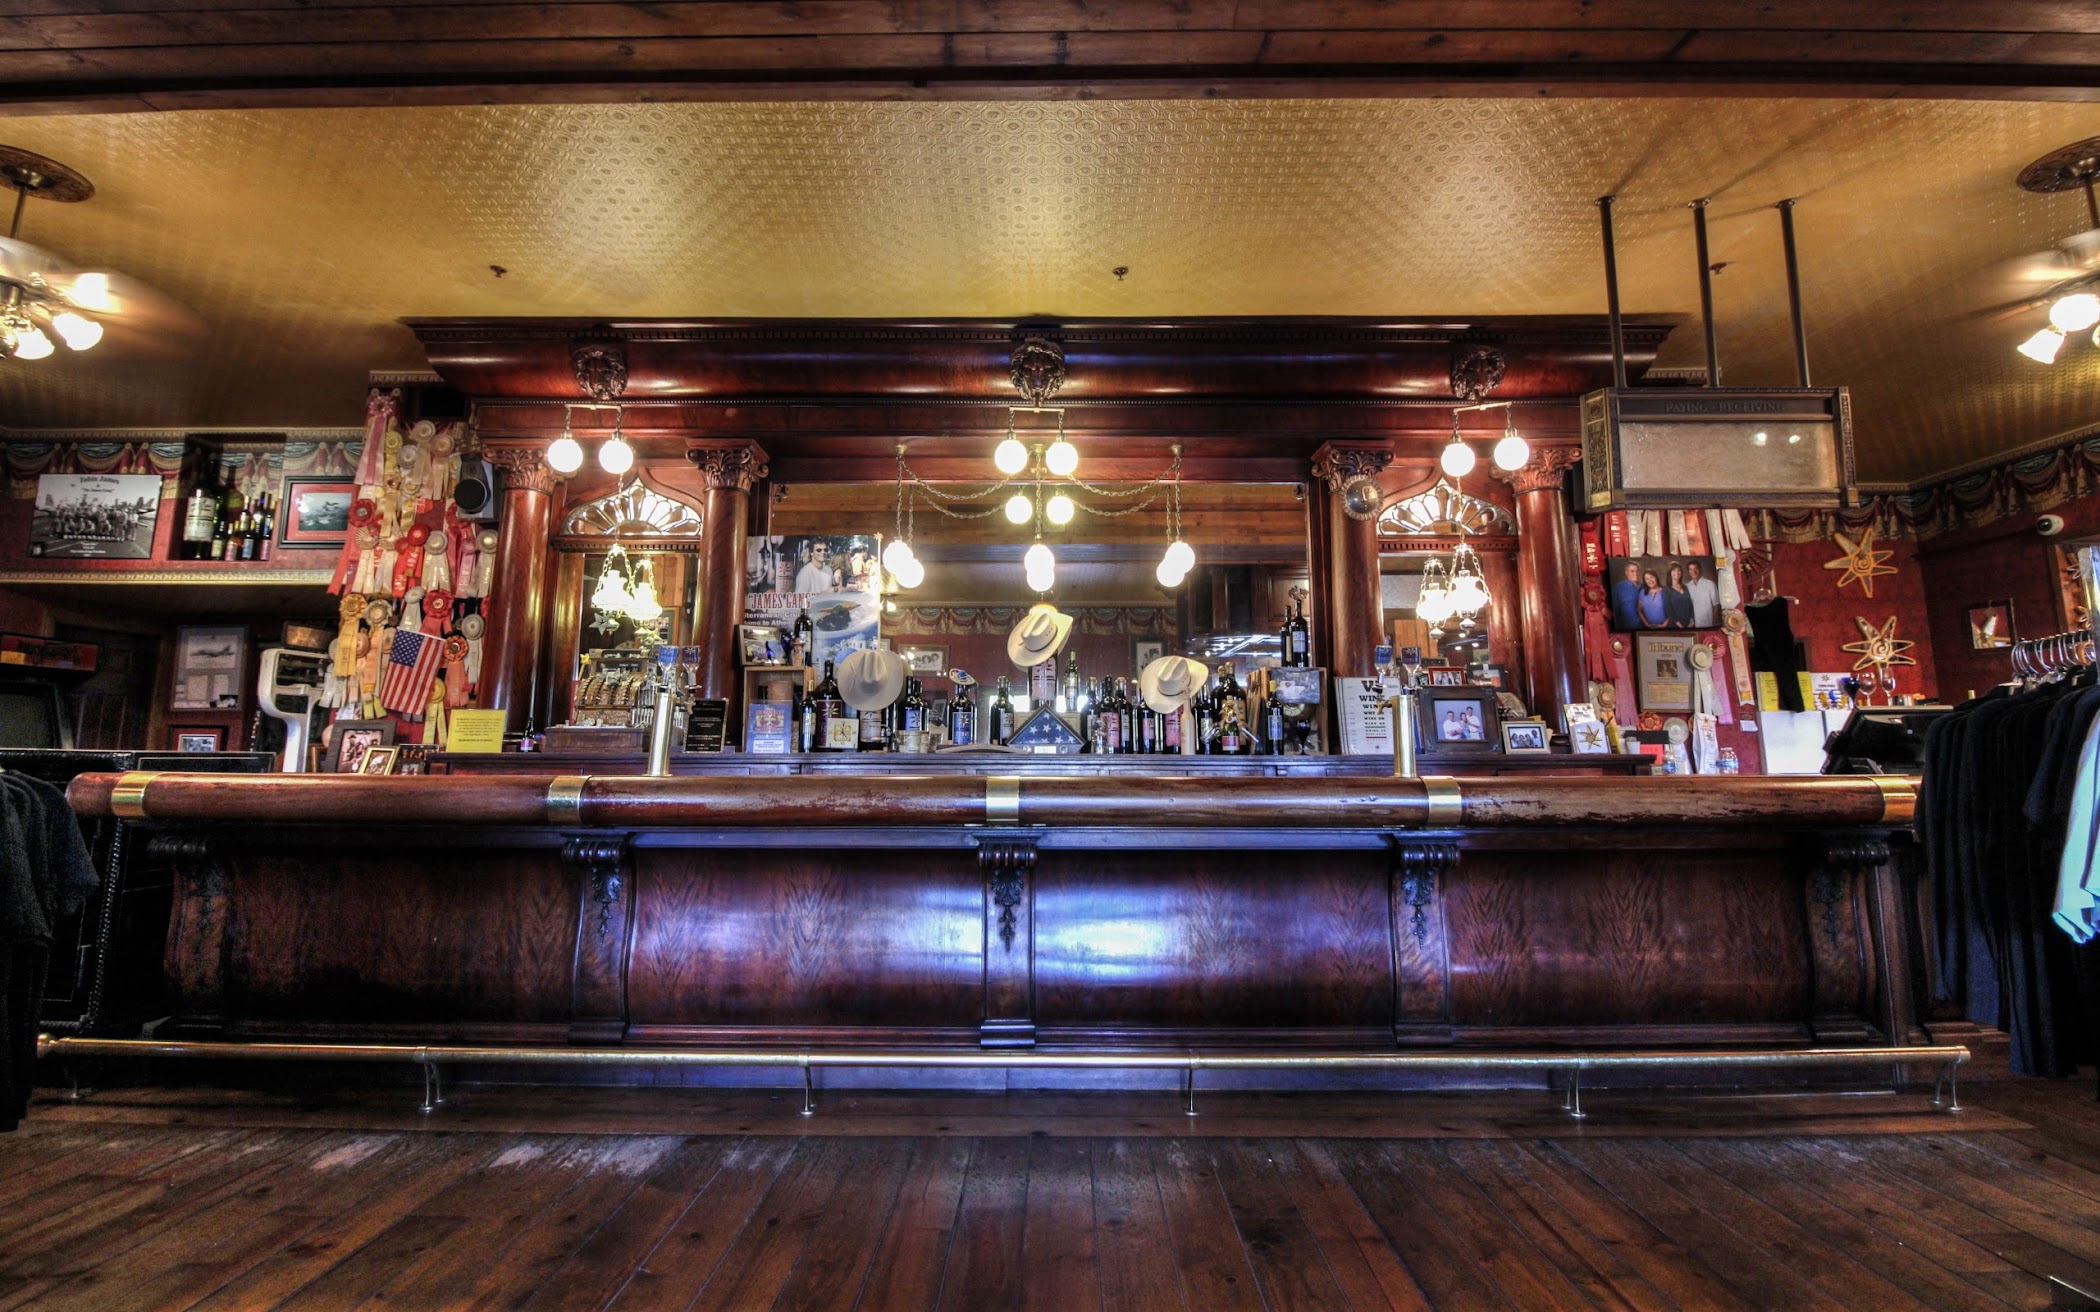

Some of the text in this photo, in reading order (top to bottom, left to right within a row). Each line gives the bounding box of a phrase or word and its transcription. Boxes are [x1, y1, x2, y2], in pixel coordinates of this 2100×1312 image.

[1665, 401, 1785, 413] PAYING RECEIVING
[748, 593, 783, 609] "JAMES
[1647, 641, 1684, 652] Tribune
